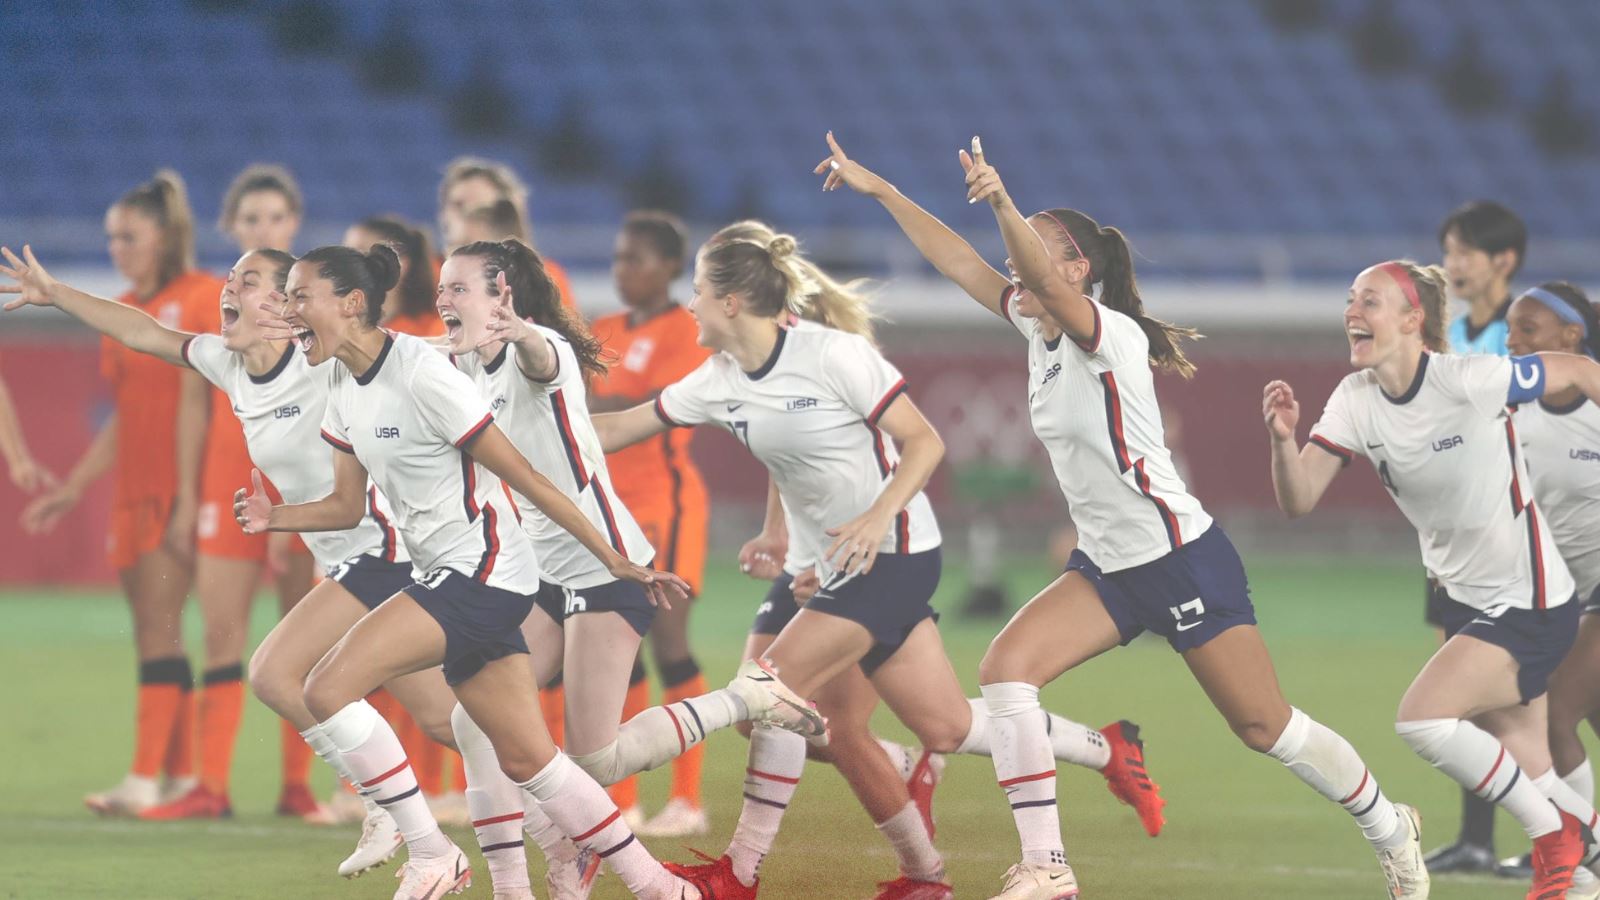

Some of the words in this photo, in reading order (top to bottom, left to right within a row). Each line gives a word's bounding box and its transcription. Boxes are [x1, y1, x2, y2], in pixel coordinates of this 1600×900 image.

[786, 398, 818, 411] USA
[274, 405, 301, 419] USA
[375, 427, 400, 439] USA
[1432, 435, 1464, 452] USA
